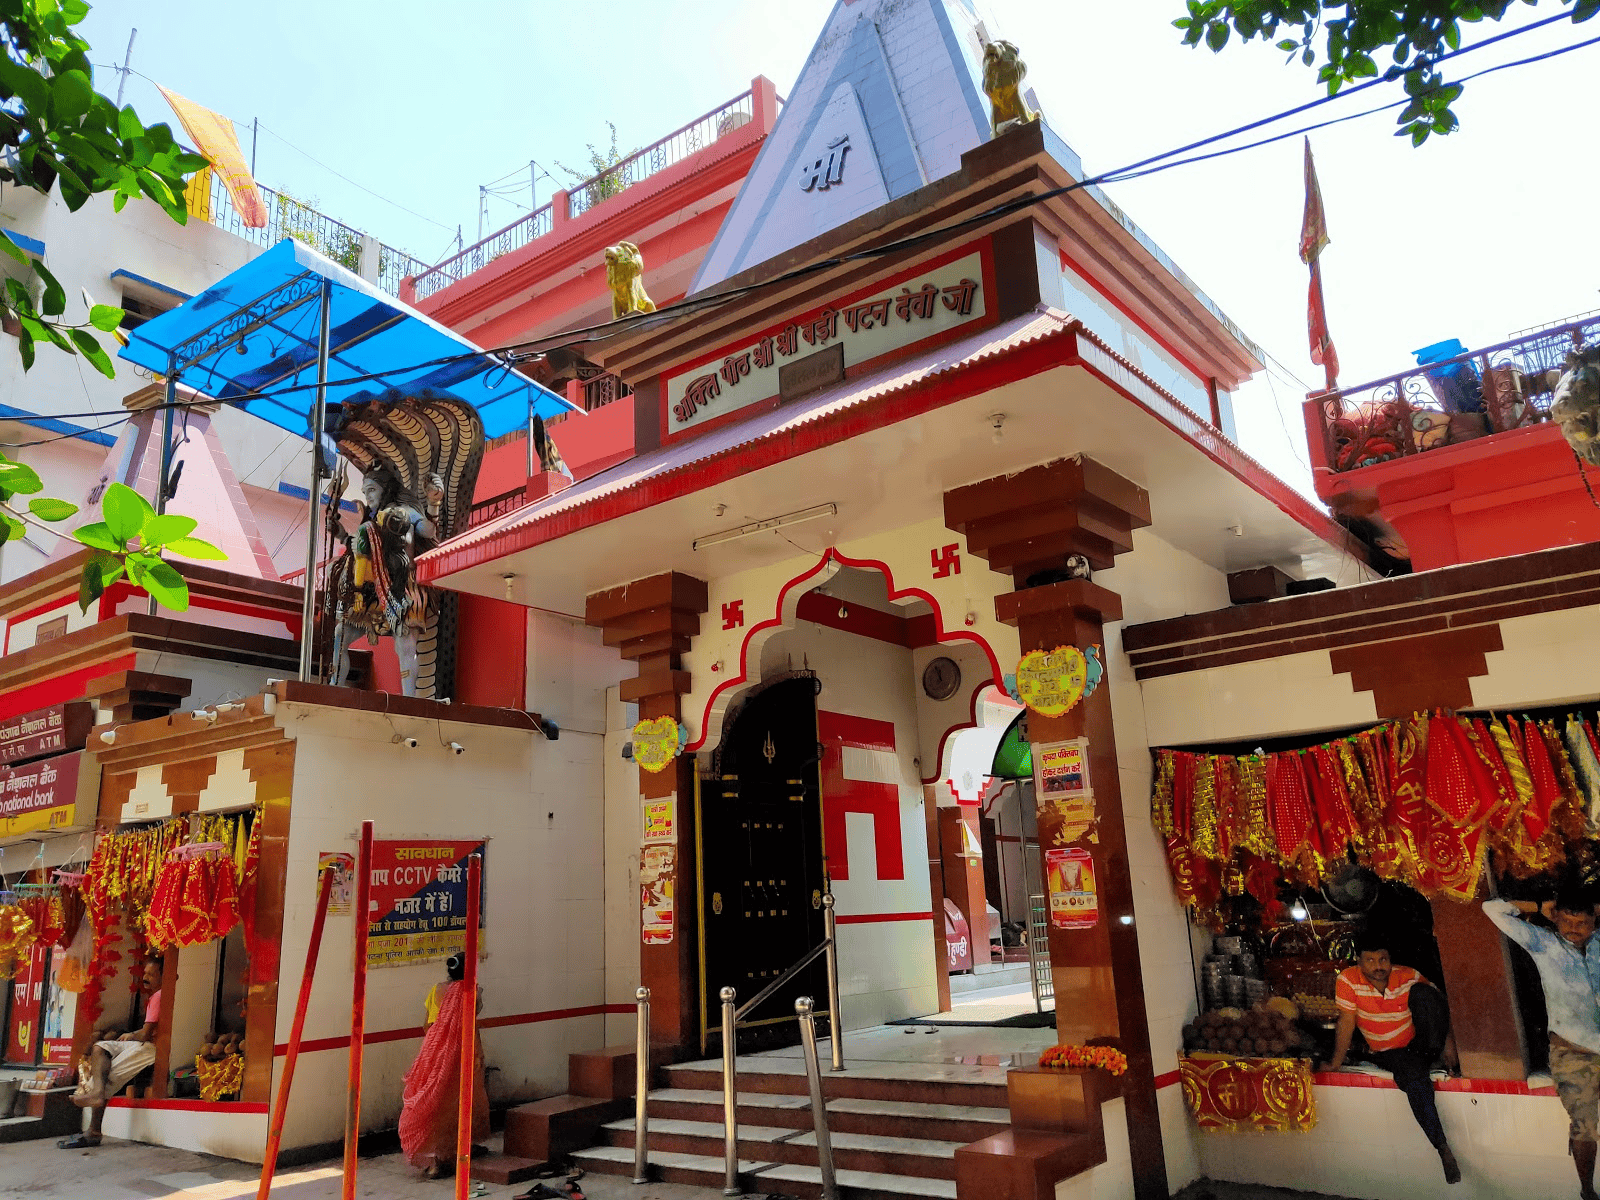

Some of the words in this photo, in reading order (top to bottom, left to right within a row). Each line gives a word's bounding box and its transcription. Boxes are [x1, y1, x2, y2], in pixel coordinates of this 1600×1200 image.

[673, 372, 721, 422] शक्ति
[719, 356, 751, 387] पीठ
[753, 335, 774, 369] श्री
[776, 323, 798, 356] श्री
[801, 305, 839, 346] बड़ी
[842, 298, 892, 333] पटन
[896, 283, 939, 322] देवी
[941, 278, 978, 316] जी
[39, 734, 61, 750] ATM
[3, 790, 34, 813] national
[34, 786, 55, 806] bank
[394, 847, 455, 861] सावधान
[393, 866, 432, 885] CCTV
[436, 863, 463, 884] कैमरे
[394, 897, 422, 915] नजर
[393, 919, 416, 930] सहयोग
[431, 916, 448, 928] 100
[394, 937, 411, 947] 201
